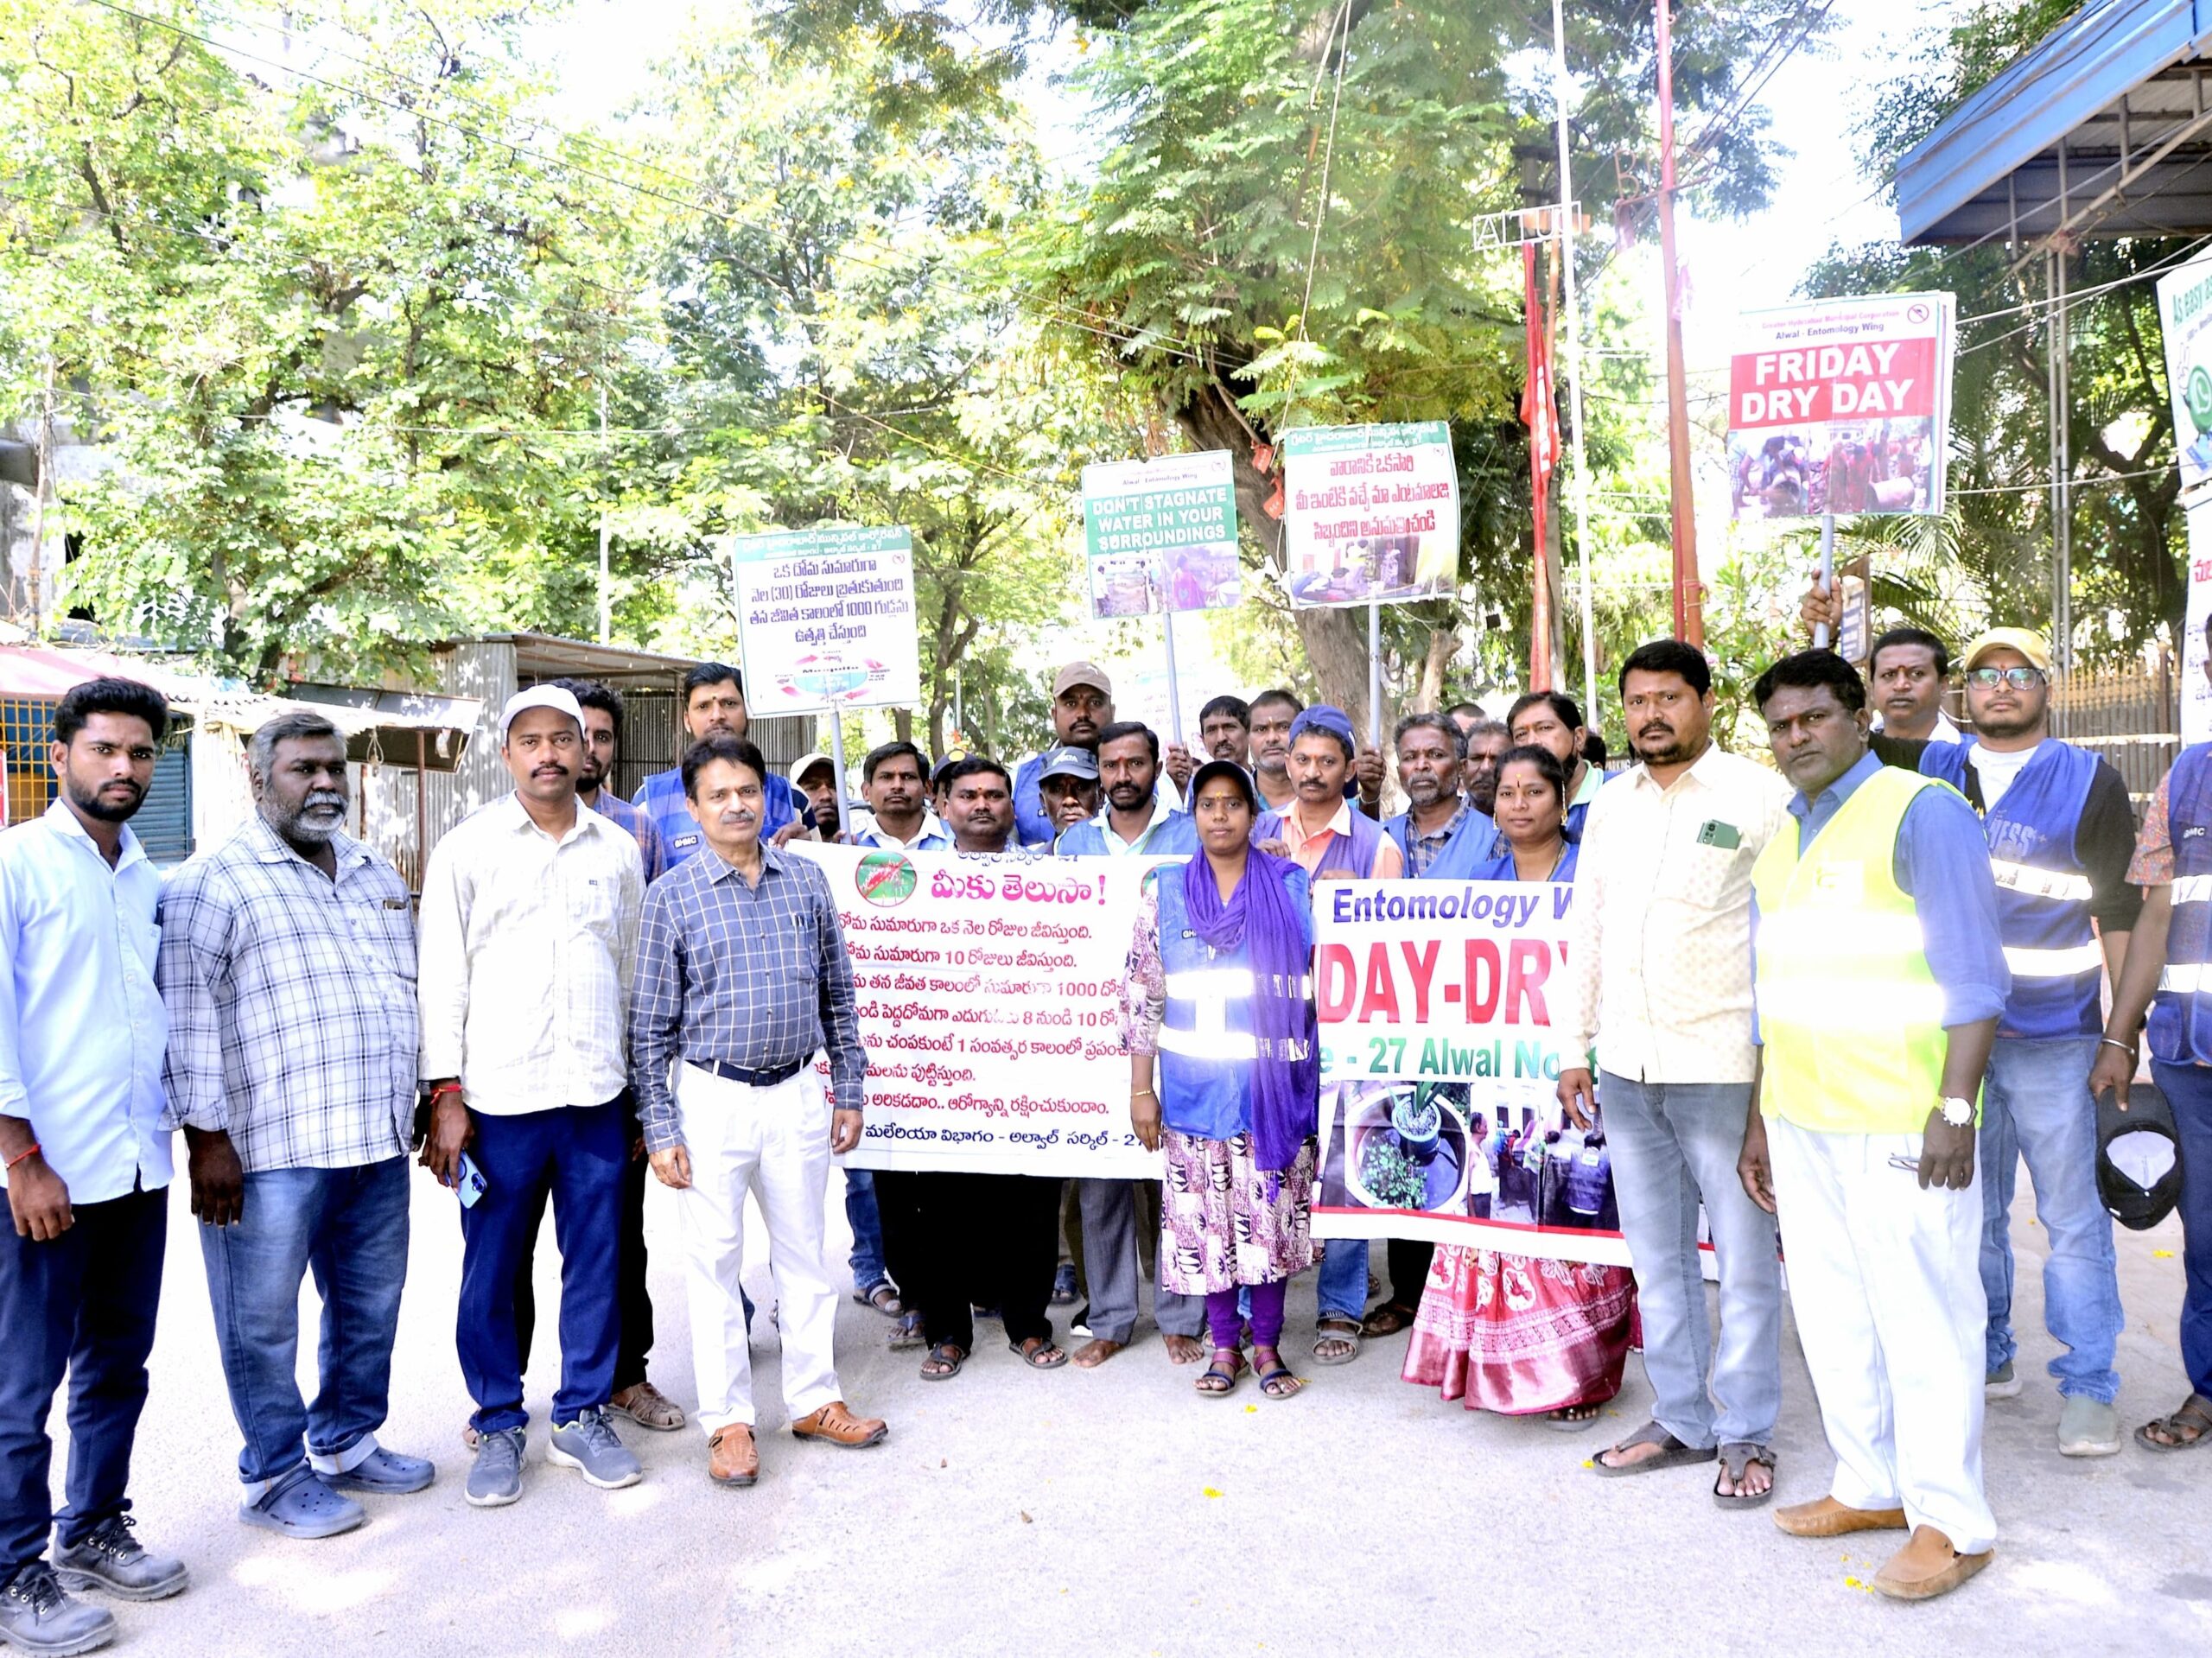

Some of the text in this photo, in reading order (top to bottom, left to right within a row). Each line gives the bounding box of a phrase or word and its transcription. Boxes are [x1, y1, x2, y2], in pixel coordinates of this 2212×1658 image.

[1477, 208, 1566, 248] AITU
[1776, 329, 1800, 340] Alwal
[1807, 323, 1859, 338] Entomology
[1861, 321, 1885, 334] Wing
[1756, 343, 1901, 385] FRIDAY
[1741, 379, 1914, 423] DRY DAY
[1092, 486, 1228, 516] DON'T STAGNATE
[1097, 506, 1224, 533] WATER IN YOUR
[1097, 524, 1226, 550] SURROUNDINGS
[773, 563, 791, 578] ఒక
[793, 559, 819, 576] దోమ
[771, 585, 793, 602] (30)
[749, 610, 768, 626] తన
[847, 600, 872, 617] 1000
[931, 869, 995, 899] మీకు
[1002, 873, 1091, 905] తెలుసా
[1333, 886, 1540, 929] Entomology
[870, 916, 937, 934] సుమారుగా
[940, 920, 959, 936] ఒక
[963, 920, 985, 936] నెల
[988, 918, 1028, 937] రోజుల
[1031, 922, 1092, 944] జీవిస్తుంది.
[1183, 929, 1197, 939] GH
[874, 945, 940, 964] సుమారుగా
[945, 950, 964, 965] 10
[969, 948, 1014, 968] రోజులు
[1016, 950, 1077, 973] జీవిస్తుంది.
[870, 975, 891, 990] తన
[930, 975, 981, 994] కాలంలో
[1058, 981, 1096, 997] 1000
[882, 1003, 949, 1028] పెద్దదోమగా
[1023, 1010, 1033, 1026] 8
[1037, 1008, 1073, 1026] నుండి
[1077, 1013, 1097, 1026] 10
[886, 1032, 955, 1052] చంపకుంటే
[959, 1039, 965, 1052] 1
[969, 1039, 1027, 1060] సంవత్సర
[1031, 1038, 1083, 1056] కాలంలో
[1369, 1037, 1408, 1074] 27
[1419, 1037, 1502, 1077] Alwal
[948, 1094, 1008, 1118] ఆరోగ్యాన్ని
[865, 1123, 937, 1140] మలేరియా
[940, 1127, 994, 1144] విభాగం
[1009, 1128, 1059, 1150] అల్వాల్
[1066, 1130, 1109, 1151] సర్కిల్
[1124, 1134, 1142, 1147] 2
